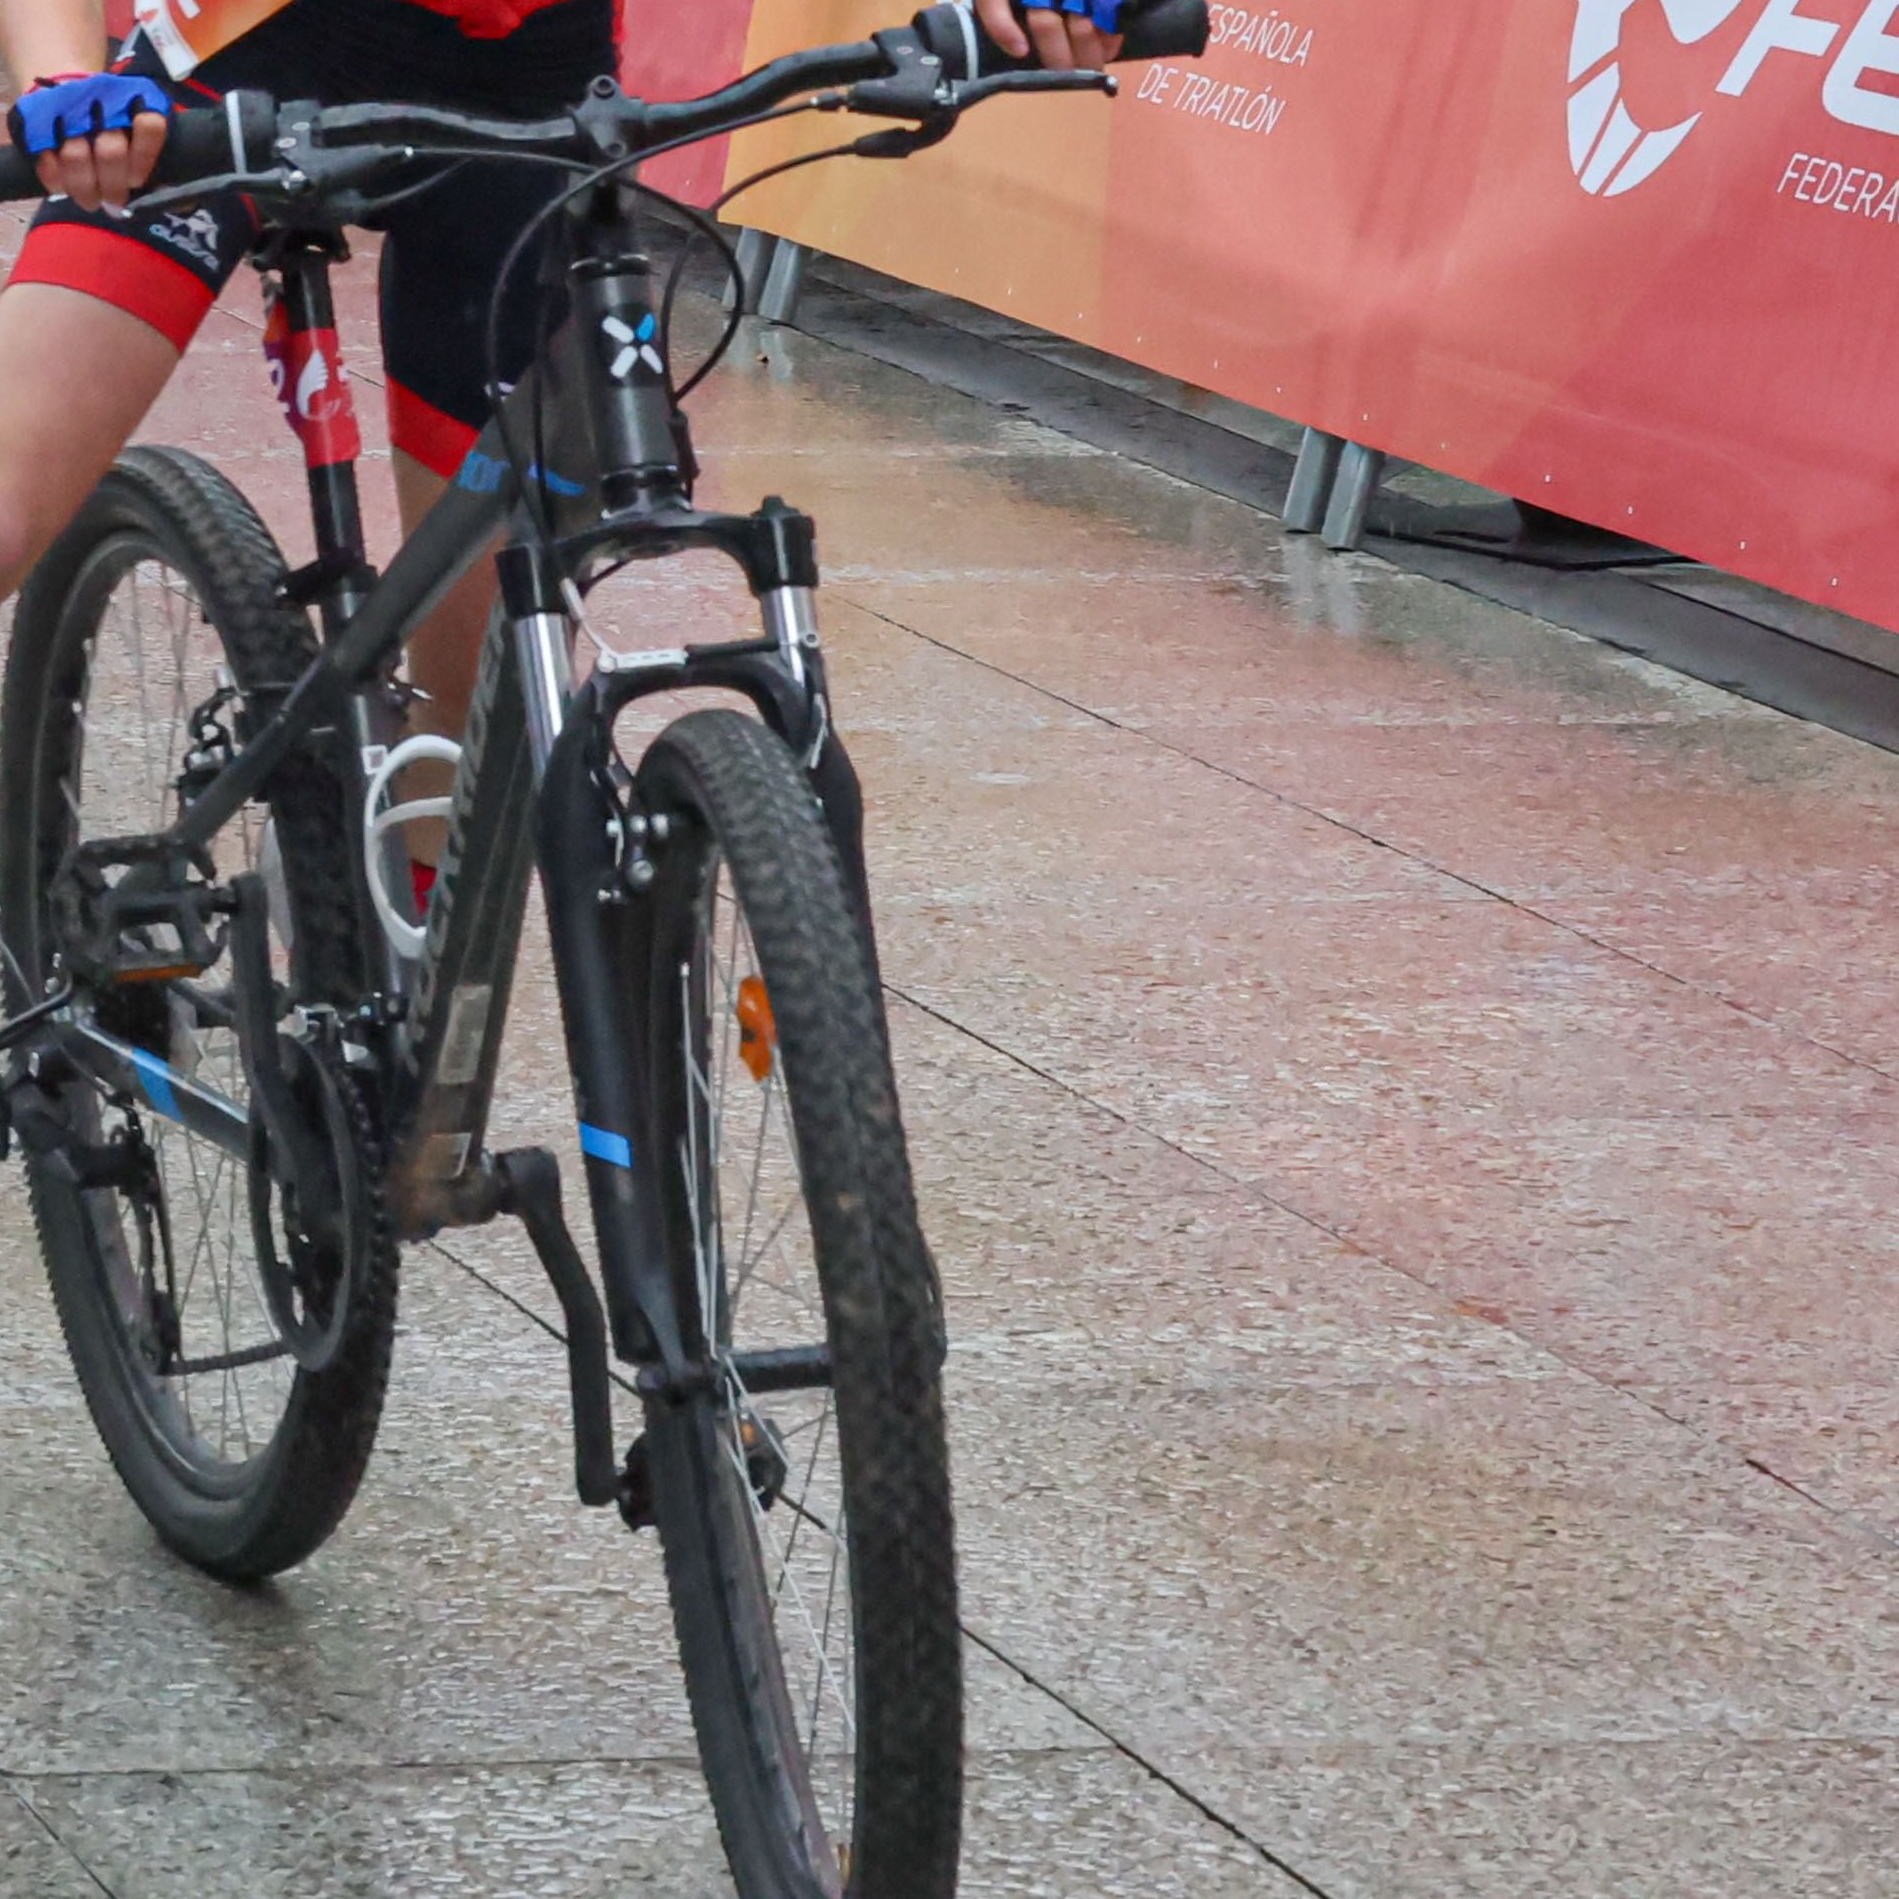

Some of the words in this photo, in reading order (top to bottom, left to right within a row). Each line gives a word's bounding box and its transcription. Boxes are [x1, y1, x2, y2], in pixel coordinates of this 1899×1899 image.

[1136, 63, 1179, 104] DE
[1173, 71, 1287, 135] TRIATLÓN
[1776, 152, 1899, 224] FEDERA
